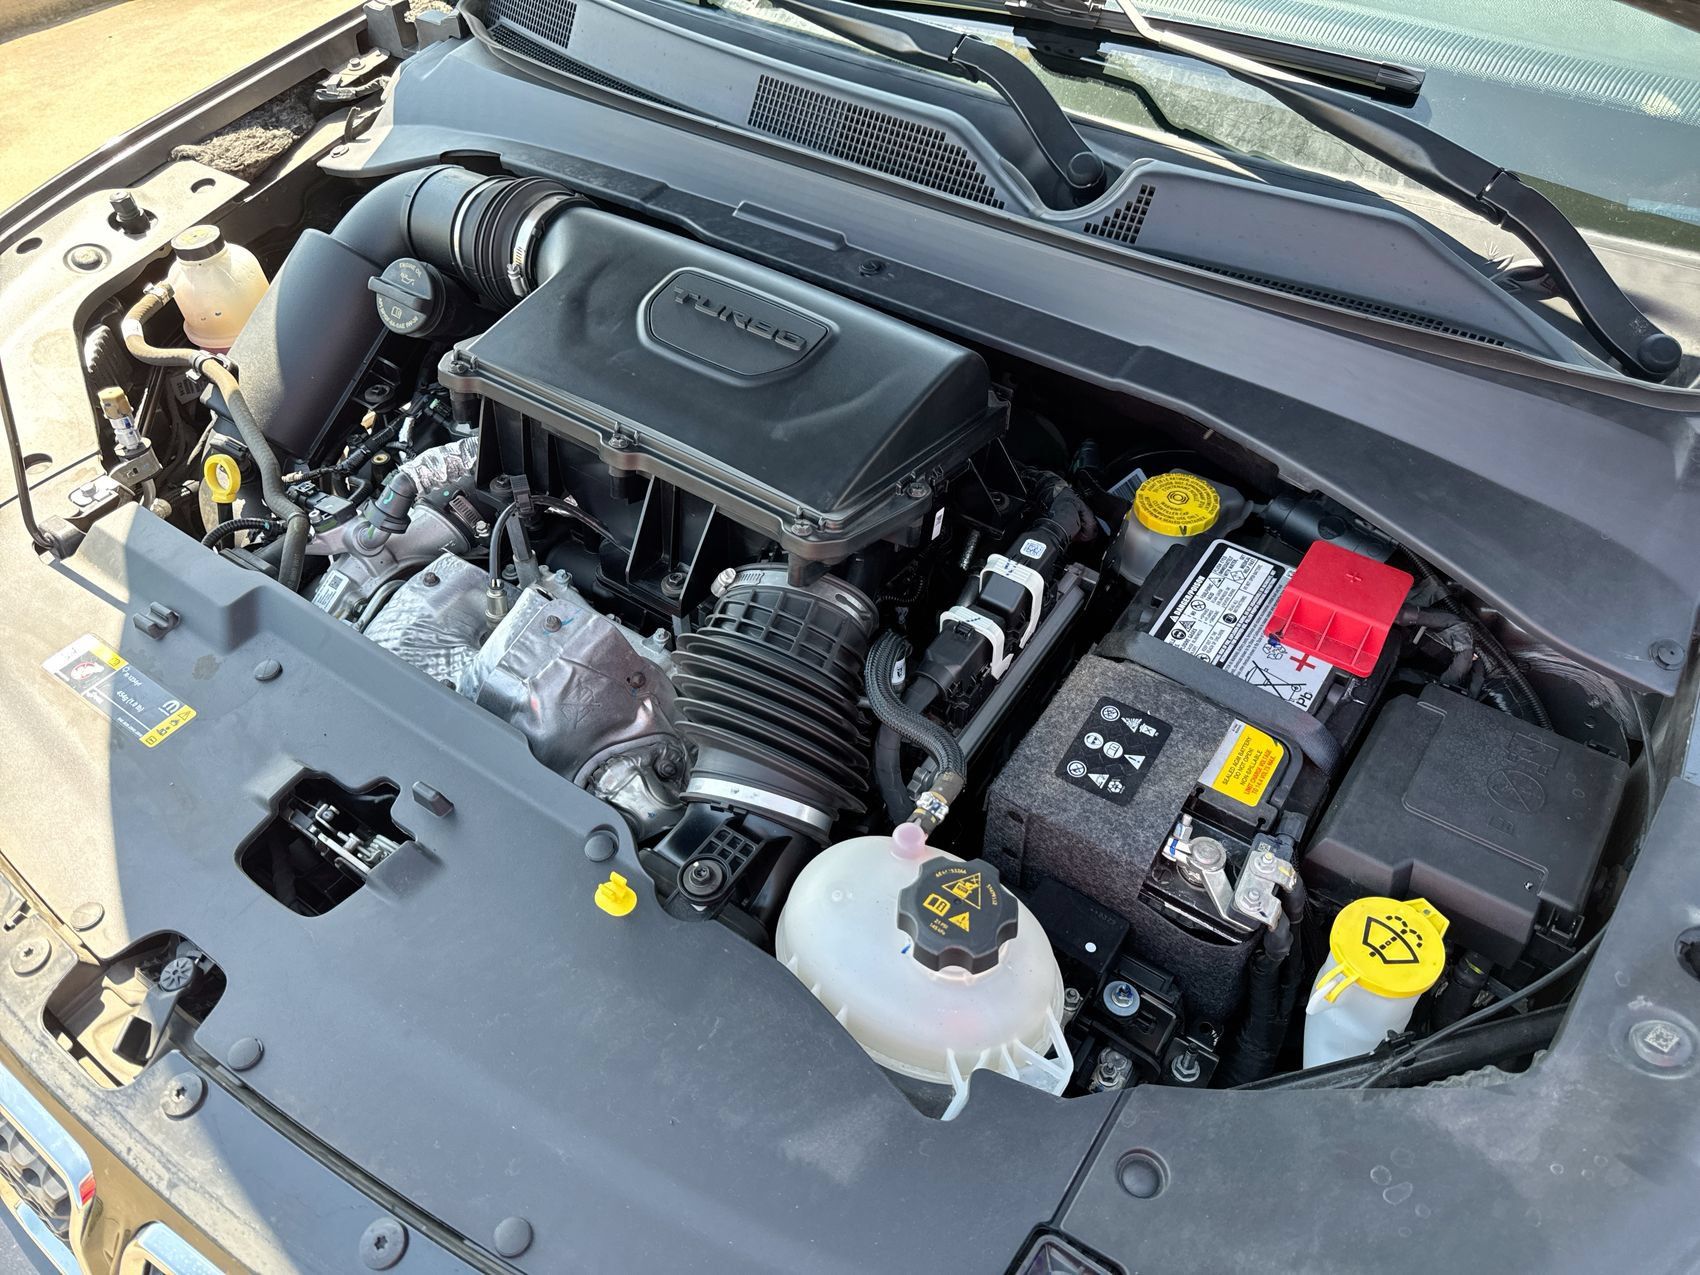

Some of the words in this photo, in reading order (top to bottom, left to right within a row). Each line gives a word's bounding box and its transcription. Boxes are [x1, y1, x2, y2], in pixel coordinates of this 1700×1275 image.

[673, 285, 807, 351] TURBO
[115, 689, 130, 702] 454g
[1297, 692, 1313, 707] Pb
[1222, 766, 1235, 785] SEALED
[1238, 736, 1252, 757] BATTERY
[1238, 762, 1246, 772] NOT
